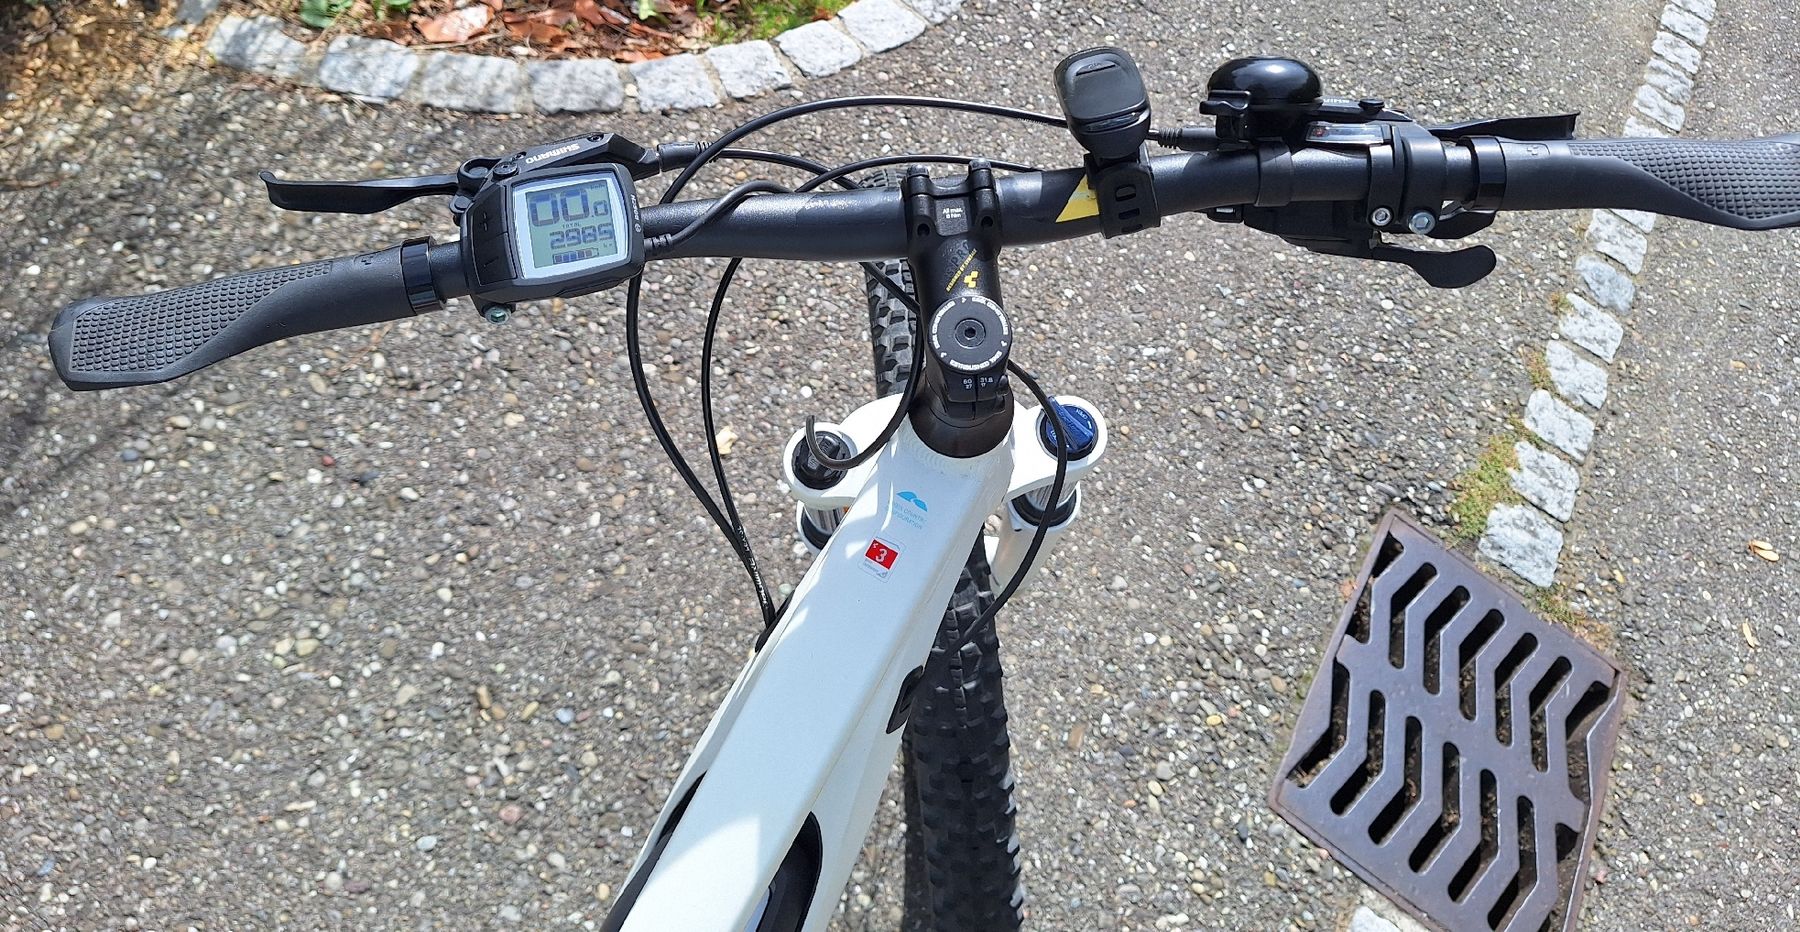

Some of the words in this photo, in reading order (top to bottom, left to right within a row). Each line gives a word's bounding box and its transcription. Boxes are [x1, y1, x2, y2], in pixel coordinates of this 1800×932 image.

[525, 143, 580, 164] SHIMANO
[630, 193, 639, 221] BOSCH
[875, 548, 888, 562] 3
